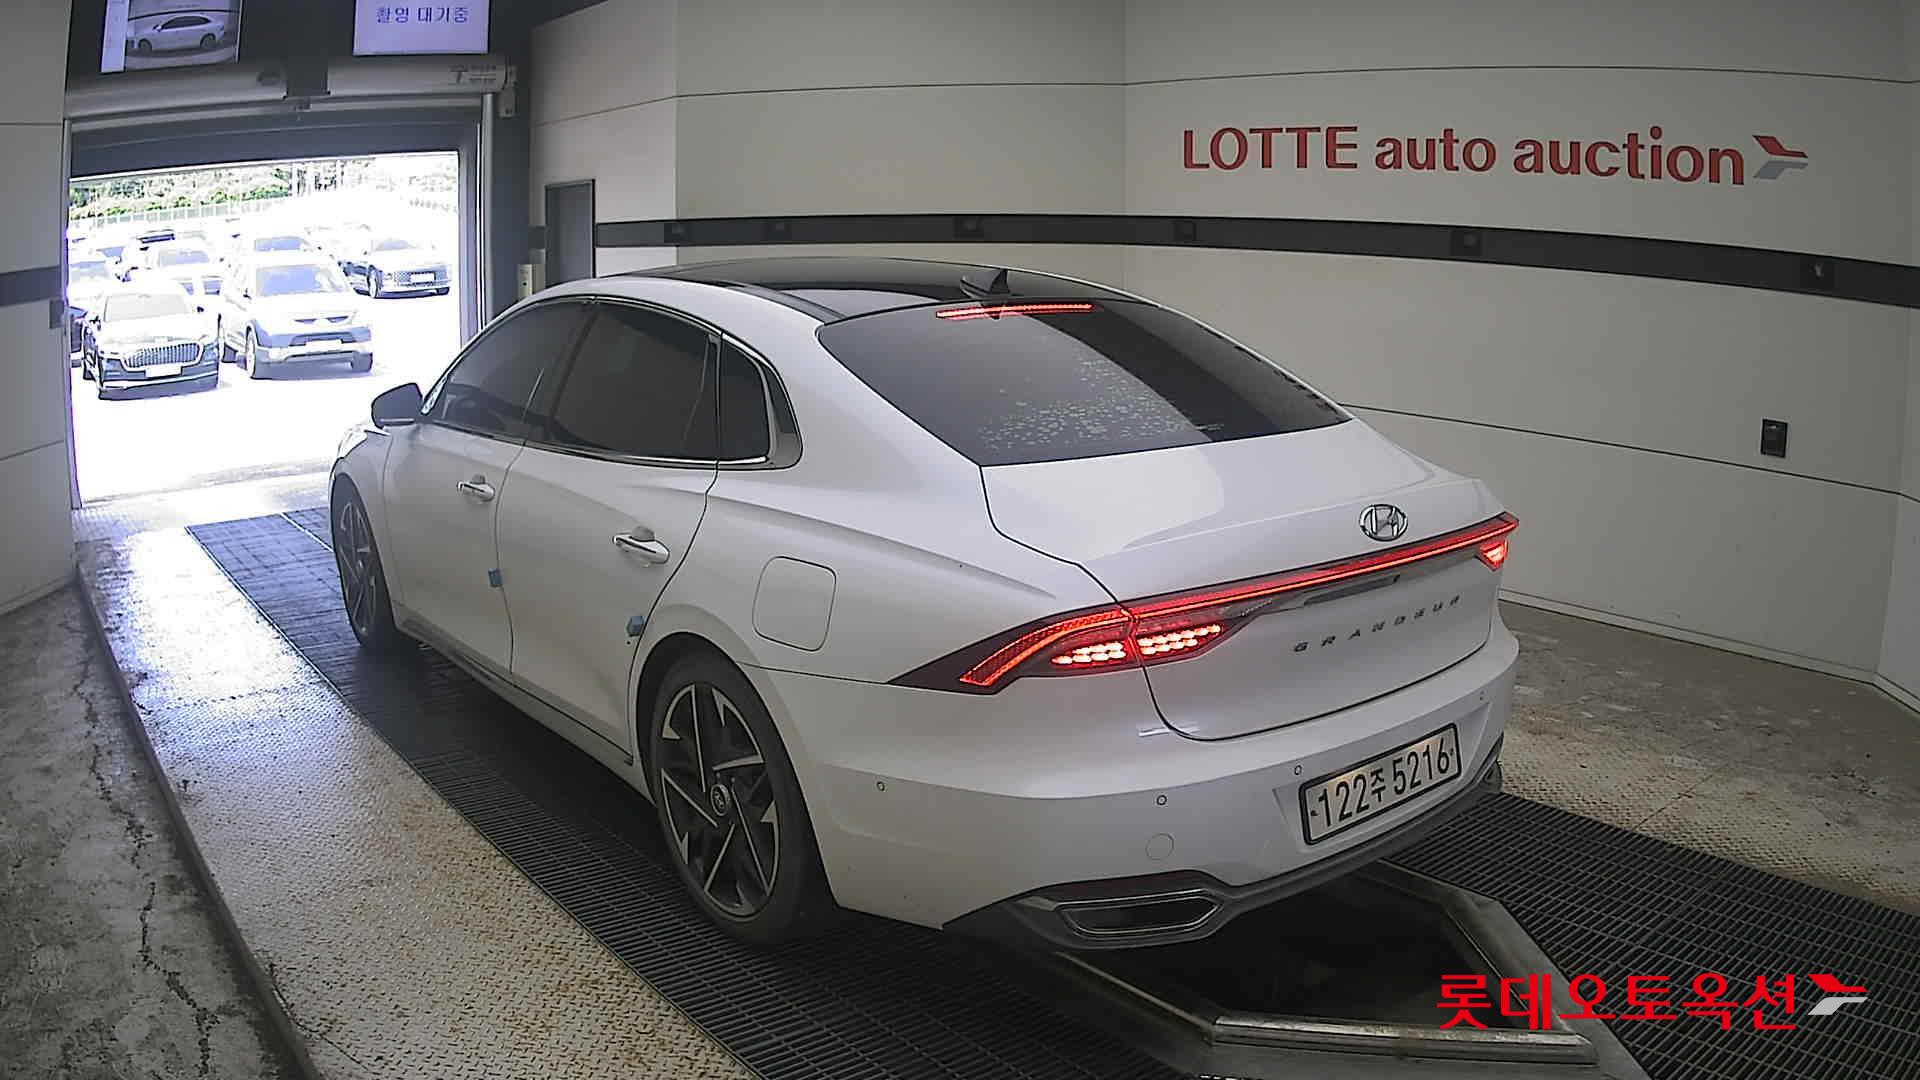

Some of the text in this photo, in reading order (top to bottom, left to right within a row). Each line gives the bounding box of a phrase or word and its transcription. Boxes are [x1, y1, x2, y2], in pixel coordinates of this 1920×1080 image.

[417, 7, 469, 23] 대기중
[1183, 125, 1744, 185] LOTTE auto auction
[1294, 595, 1460, 652] GRANDEUR
[1318, 737, 1450, 827] 122주 5216
